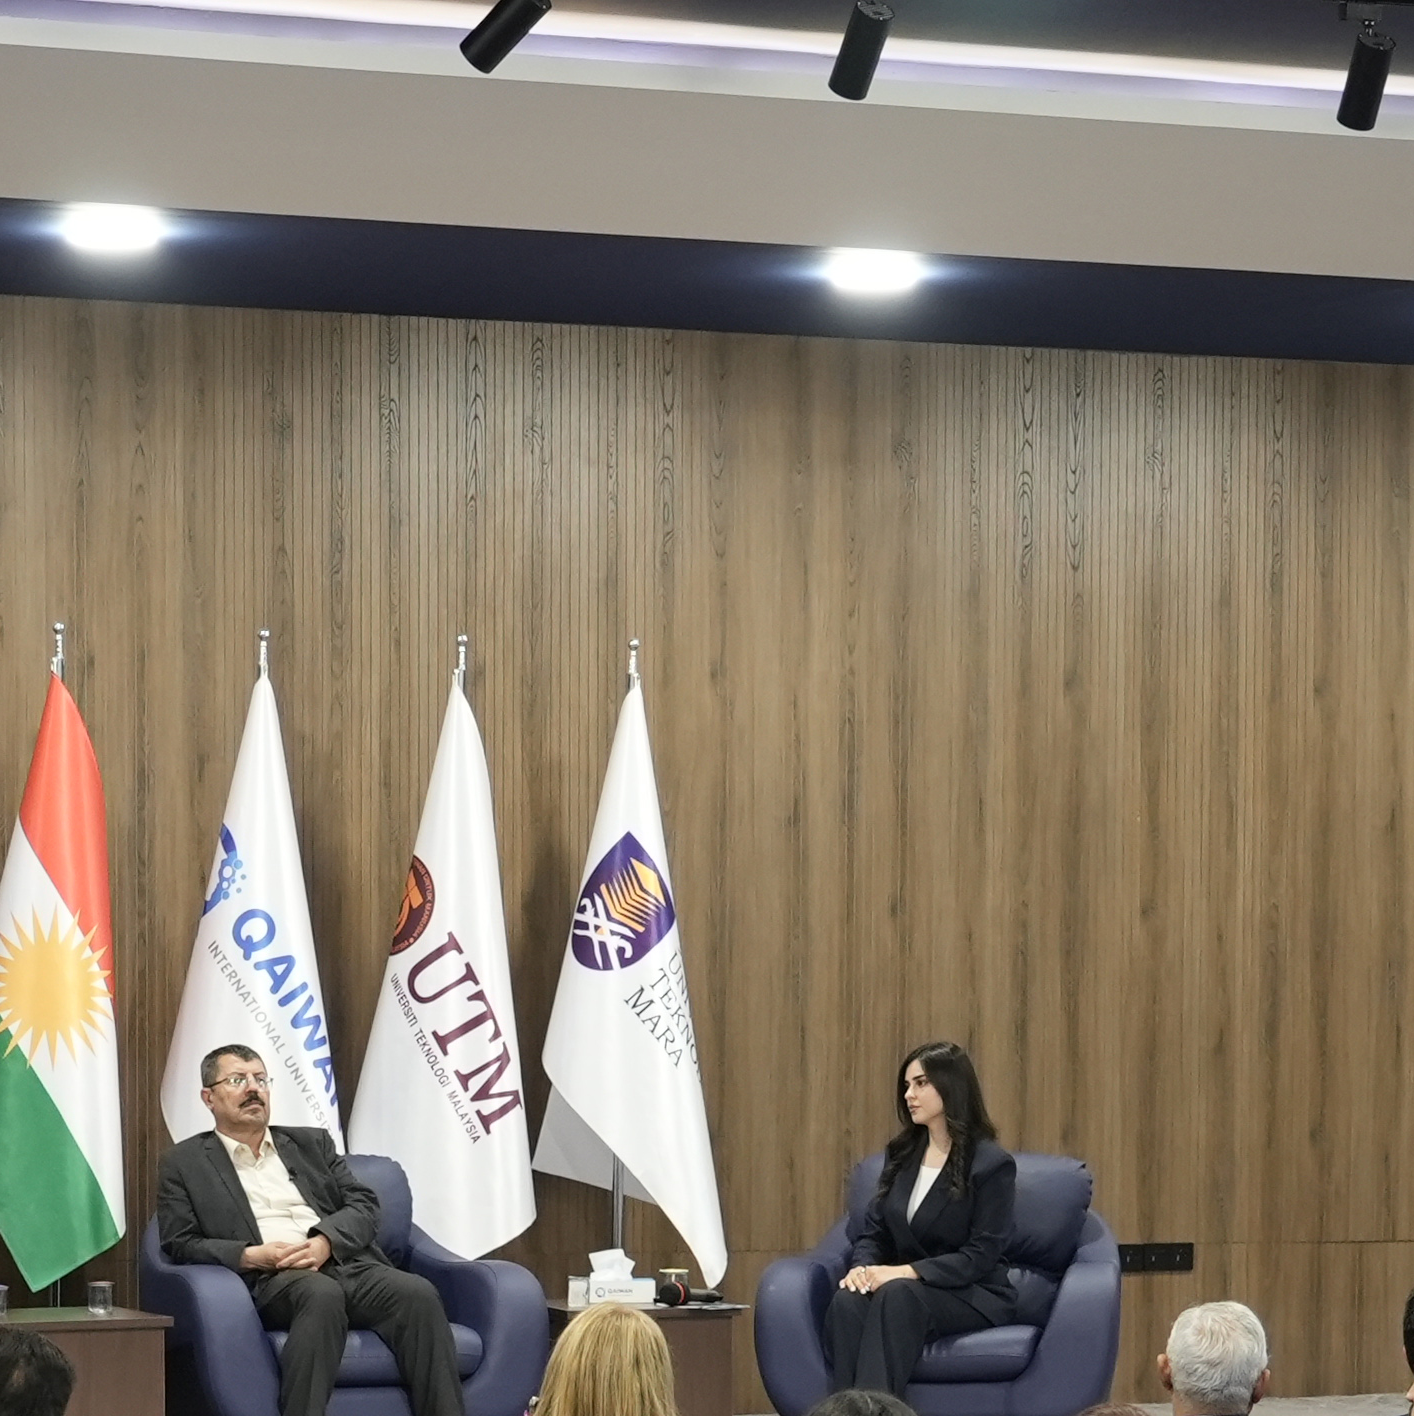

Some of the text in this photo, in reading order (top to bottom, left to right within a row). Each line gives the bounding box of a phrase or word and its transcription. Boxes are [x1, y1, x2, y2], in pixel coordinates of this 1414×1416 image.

[208, 940, 286, 1055] INTERNATIONAL
[232, 908, 341, 1131] QAIWA
[390, 973, 418, 1028] UNIVERSITI
[413, 1029, 450, 1088] TEKNOLOGI
[446, 1089, 482, 1144] MALAYSIA
[407, 931, 524, 1136] UTM
[623, 984, 684, 1068] MARA
